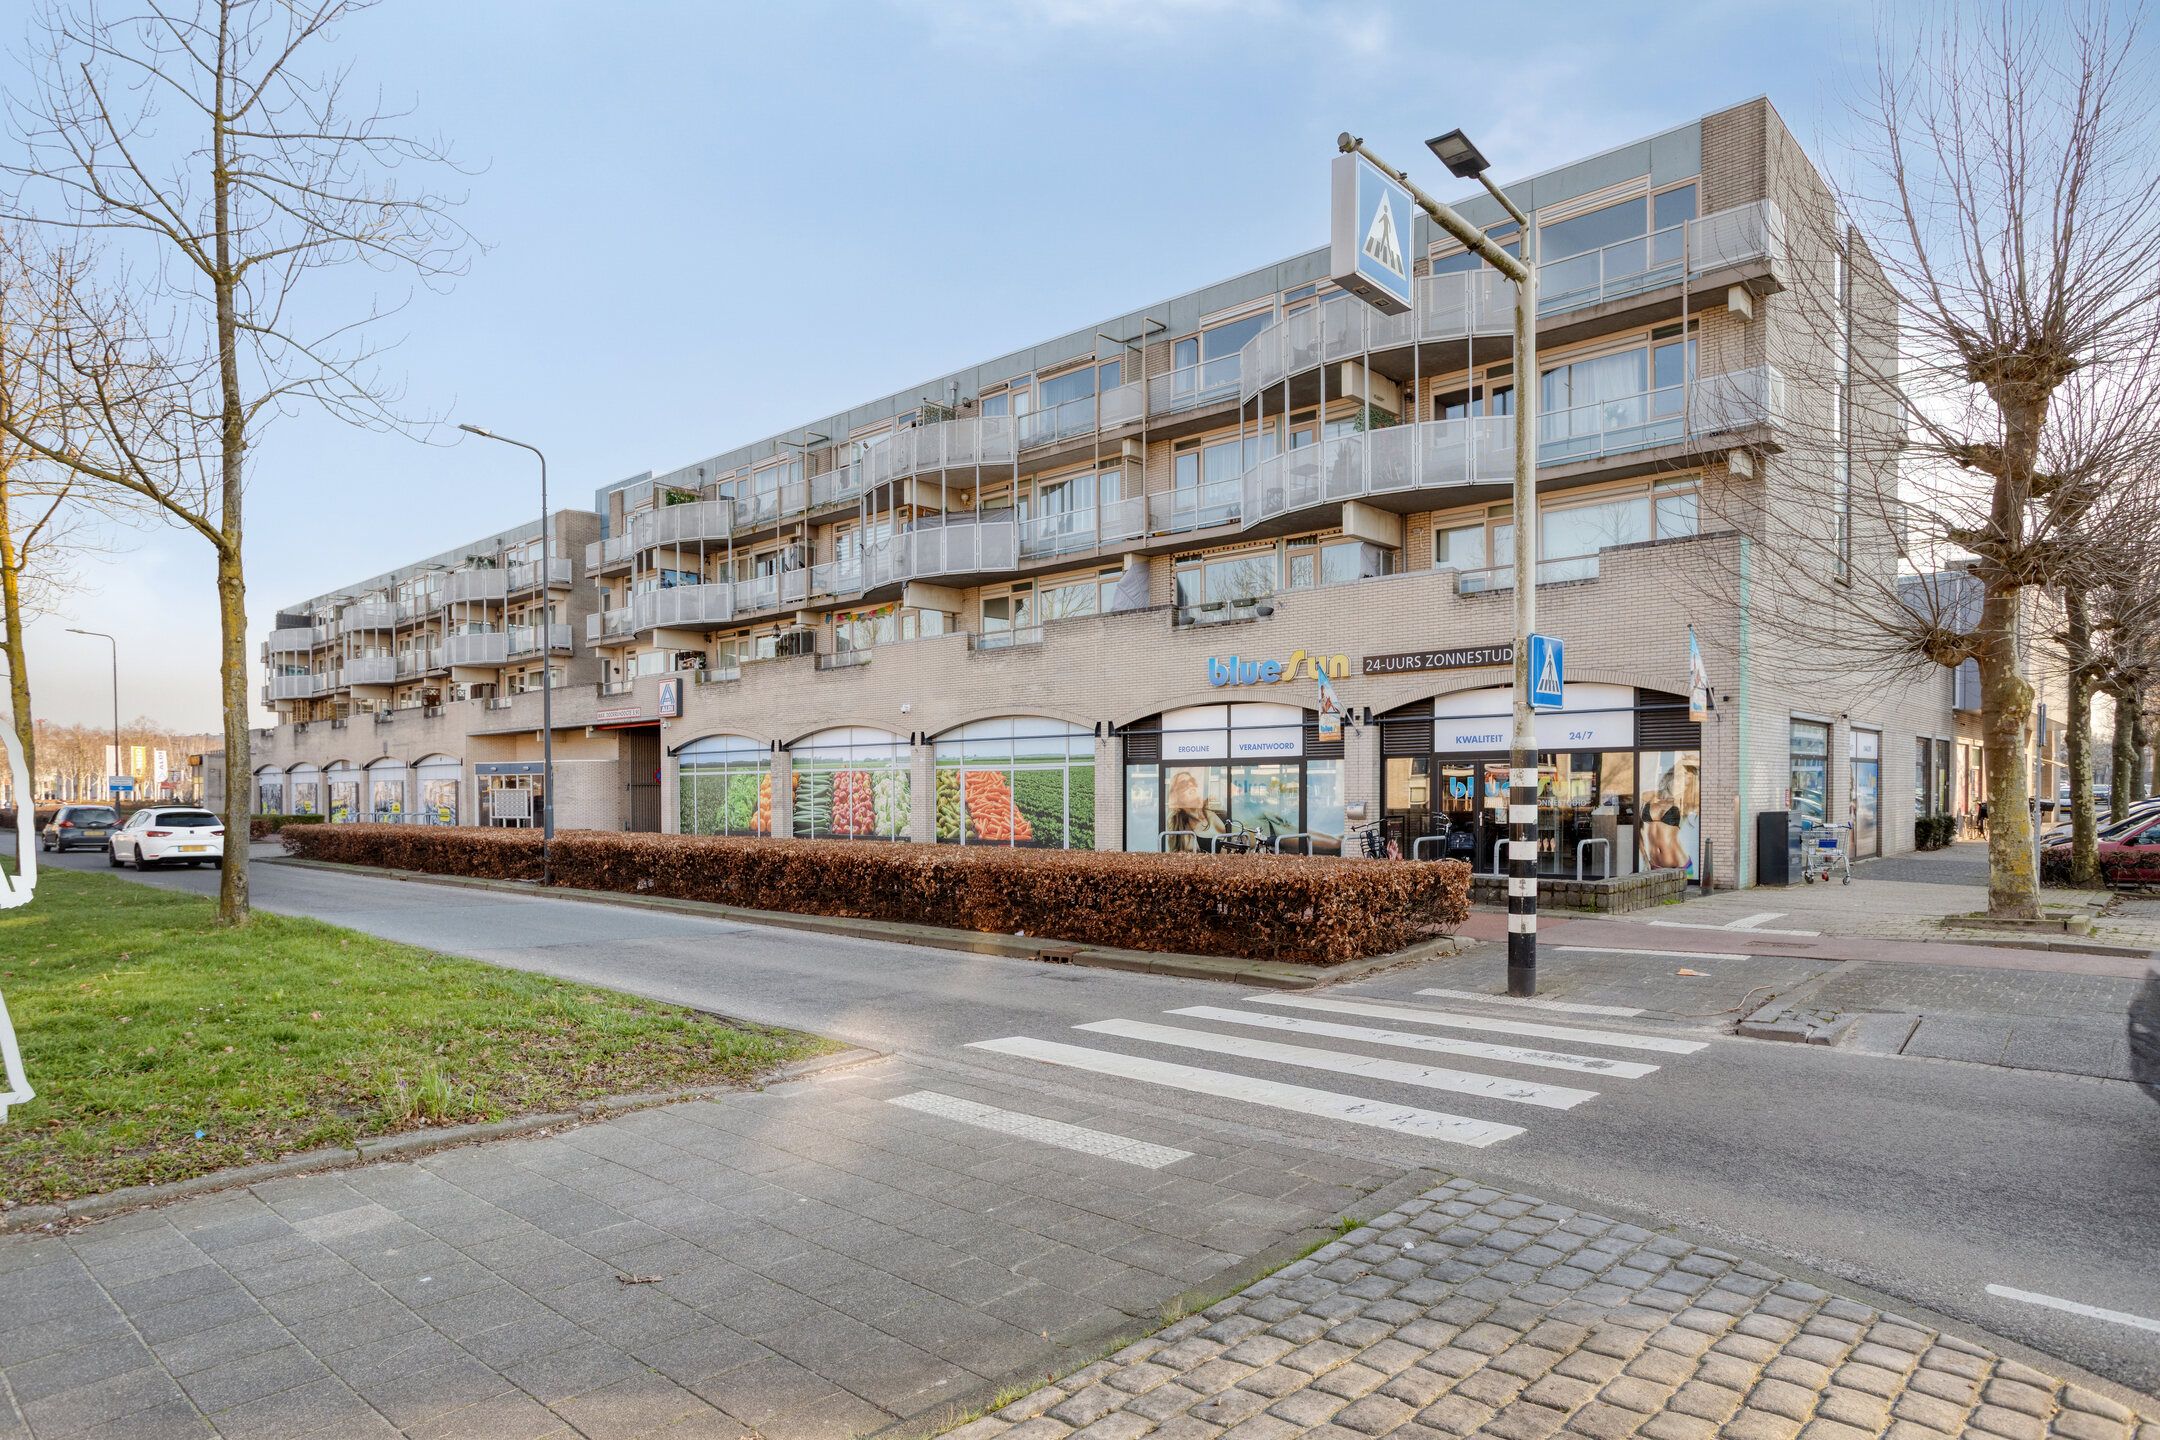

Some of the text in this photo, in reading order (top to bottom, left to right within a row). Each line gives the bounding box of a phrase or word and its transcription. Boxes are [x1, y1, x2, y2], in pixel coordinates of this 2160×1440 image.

[1366, 648, 1513, 672] 24-UURS ZONNESTUD
[1455, 734, 1504, 744] KWALITEIT
[1569, 731, 1594, 740] 24/7
[1178, 745, 1210, 753] ERGOLINE
[1239, 742, 1295, 751] VERANTWOORD
[1537, 799, 1587, 808] ONNESTUDIO
